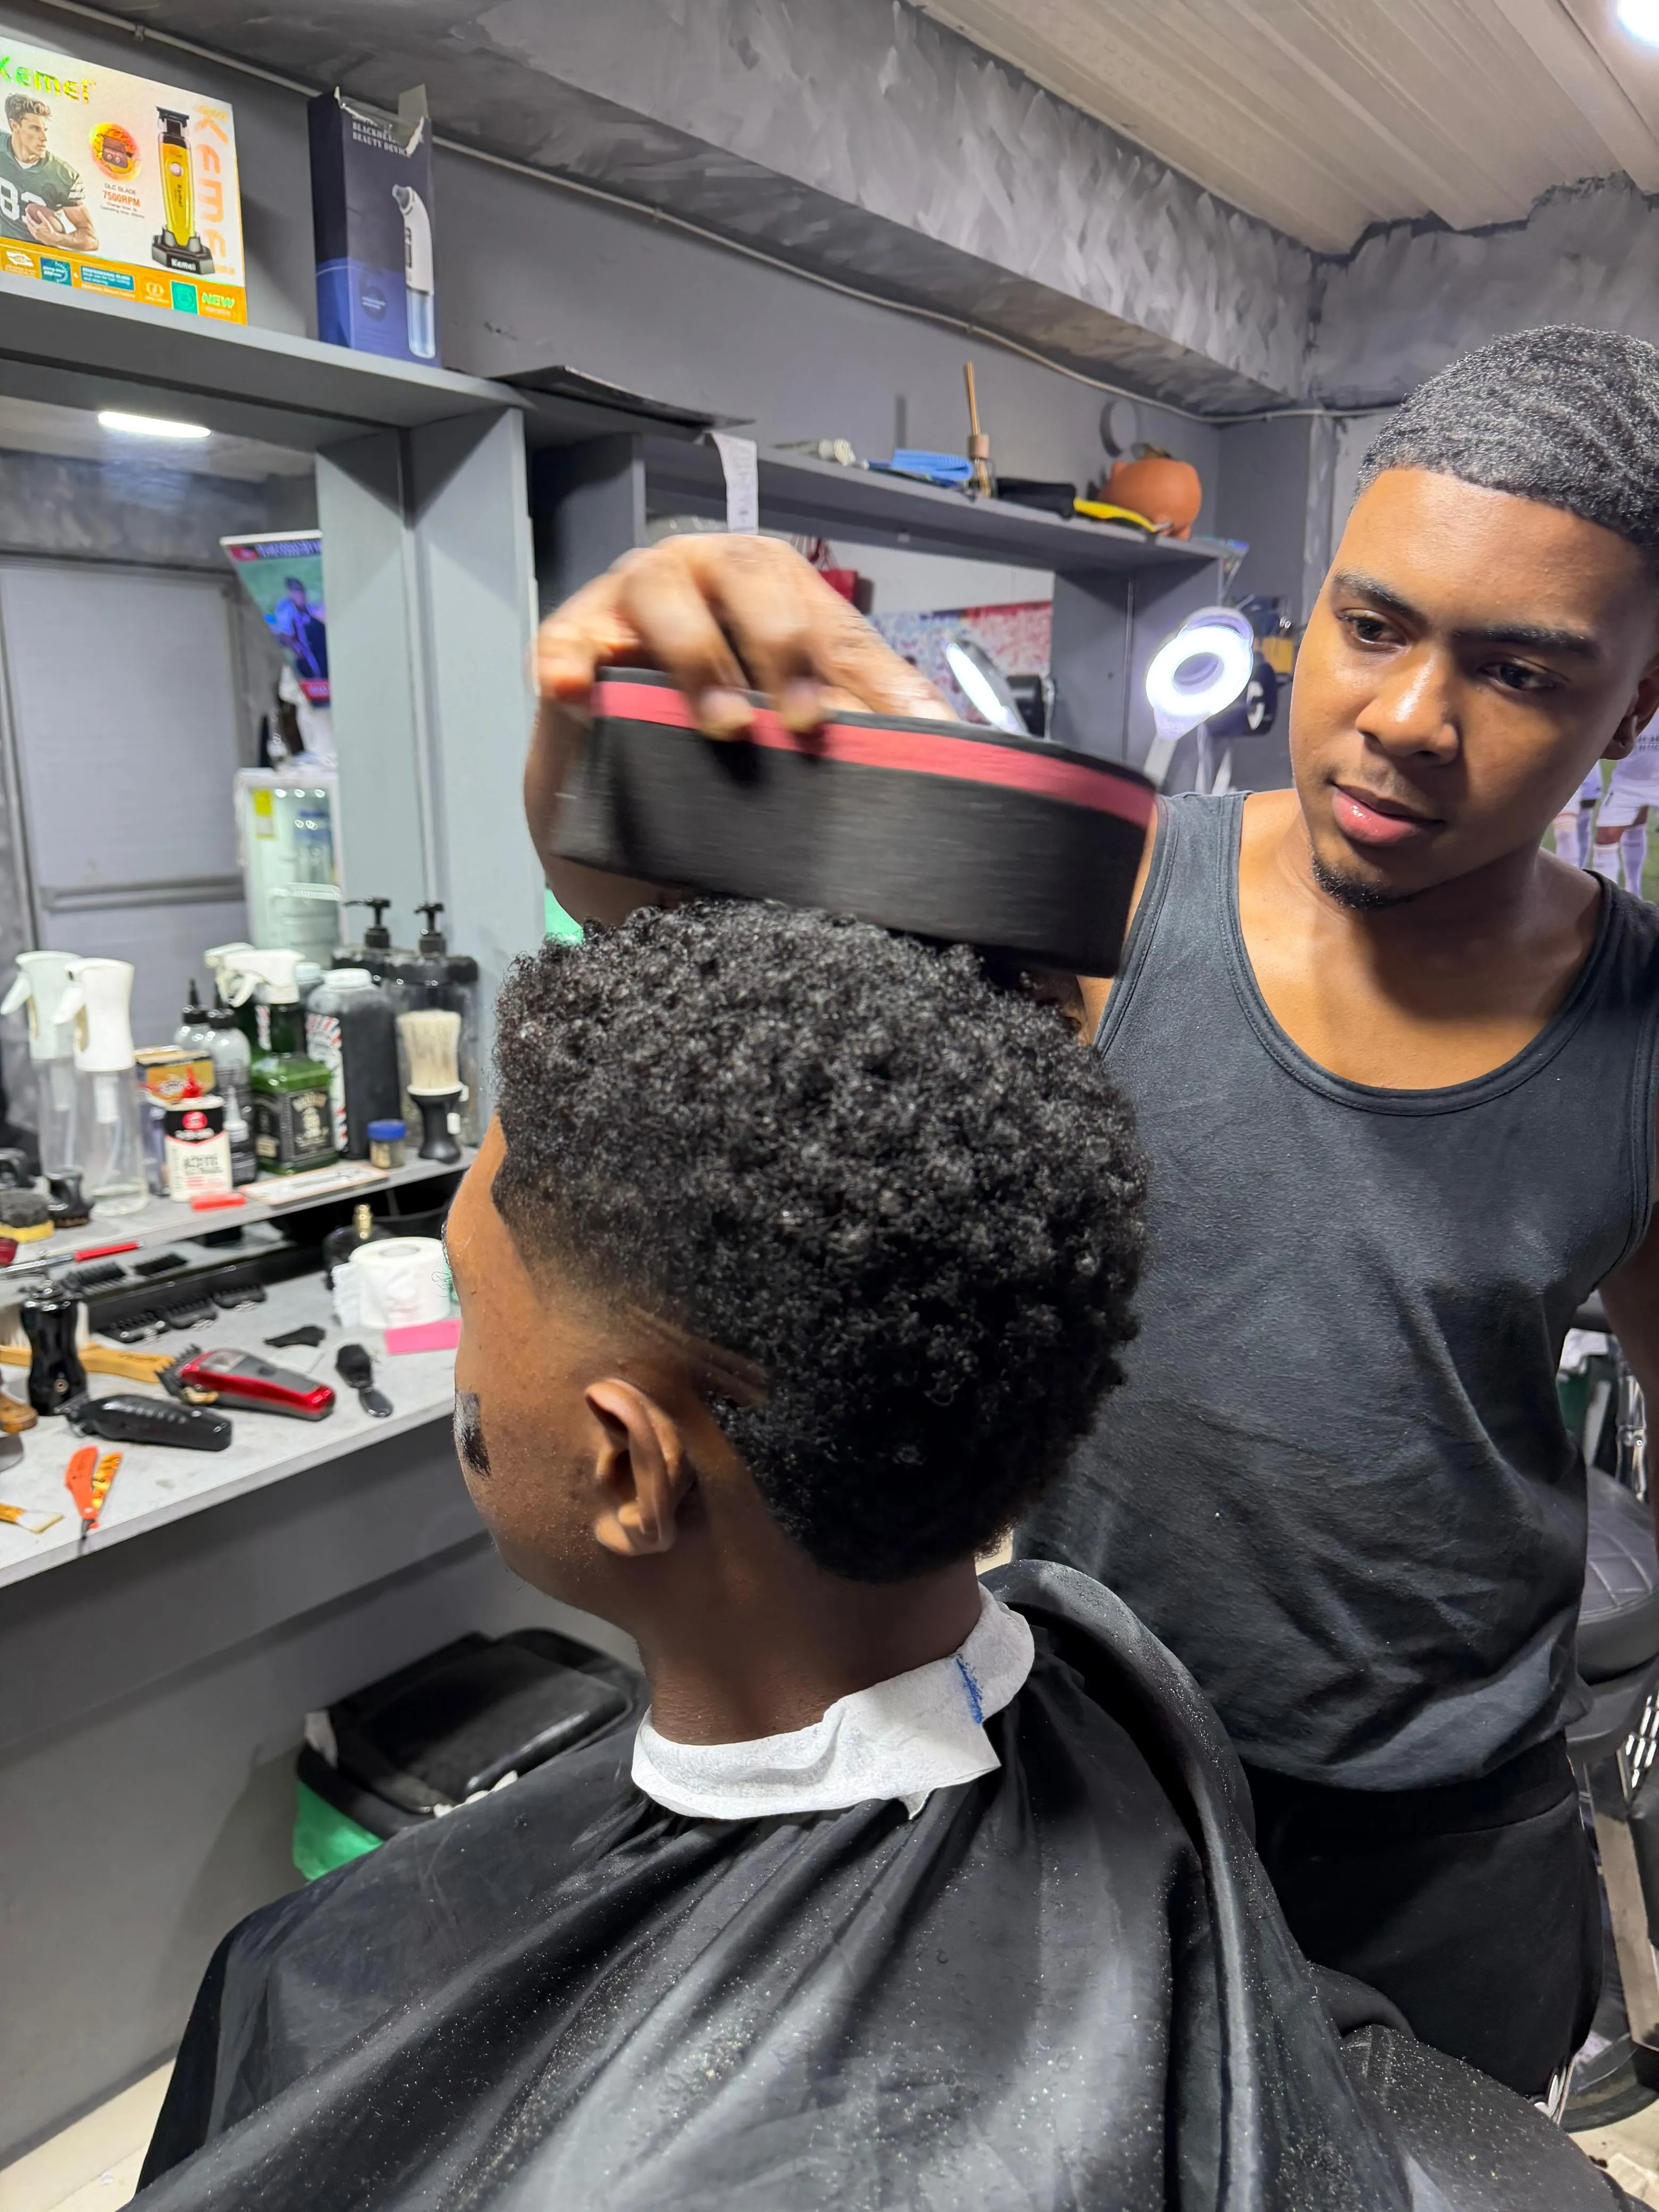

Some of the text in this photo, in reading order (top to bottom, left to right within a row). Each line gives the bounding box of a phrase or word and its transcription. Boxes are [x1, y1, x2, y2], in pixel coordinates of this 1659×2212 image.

[353, 131, 382, 148] BEAUTY
[103, 190, 140, 207] 7500RPM
[202, 292, 235, 309] NEW
